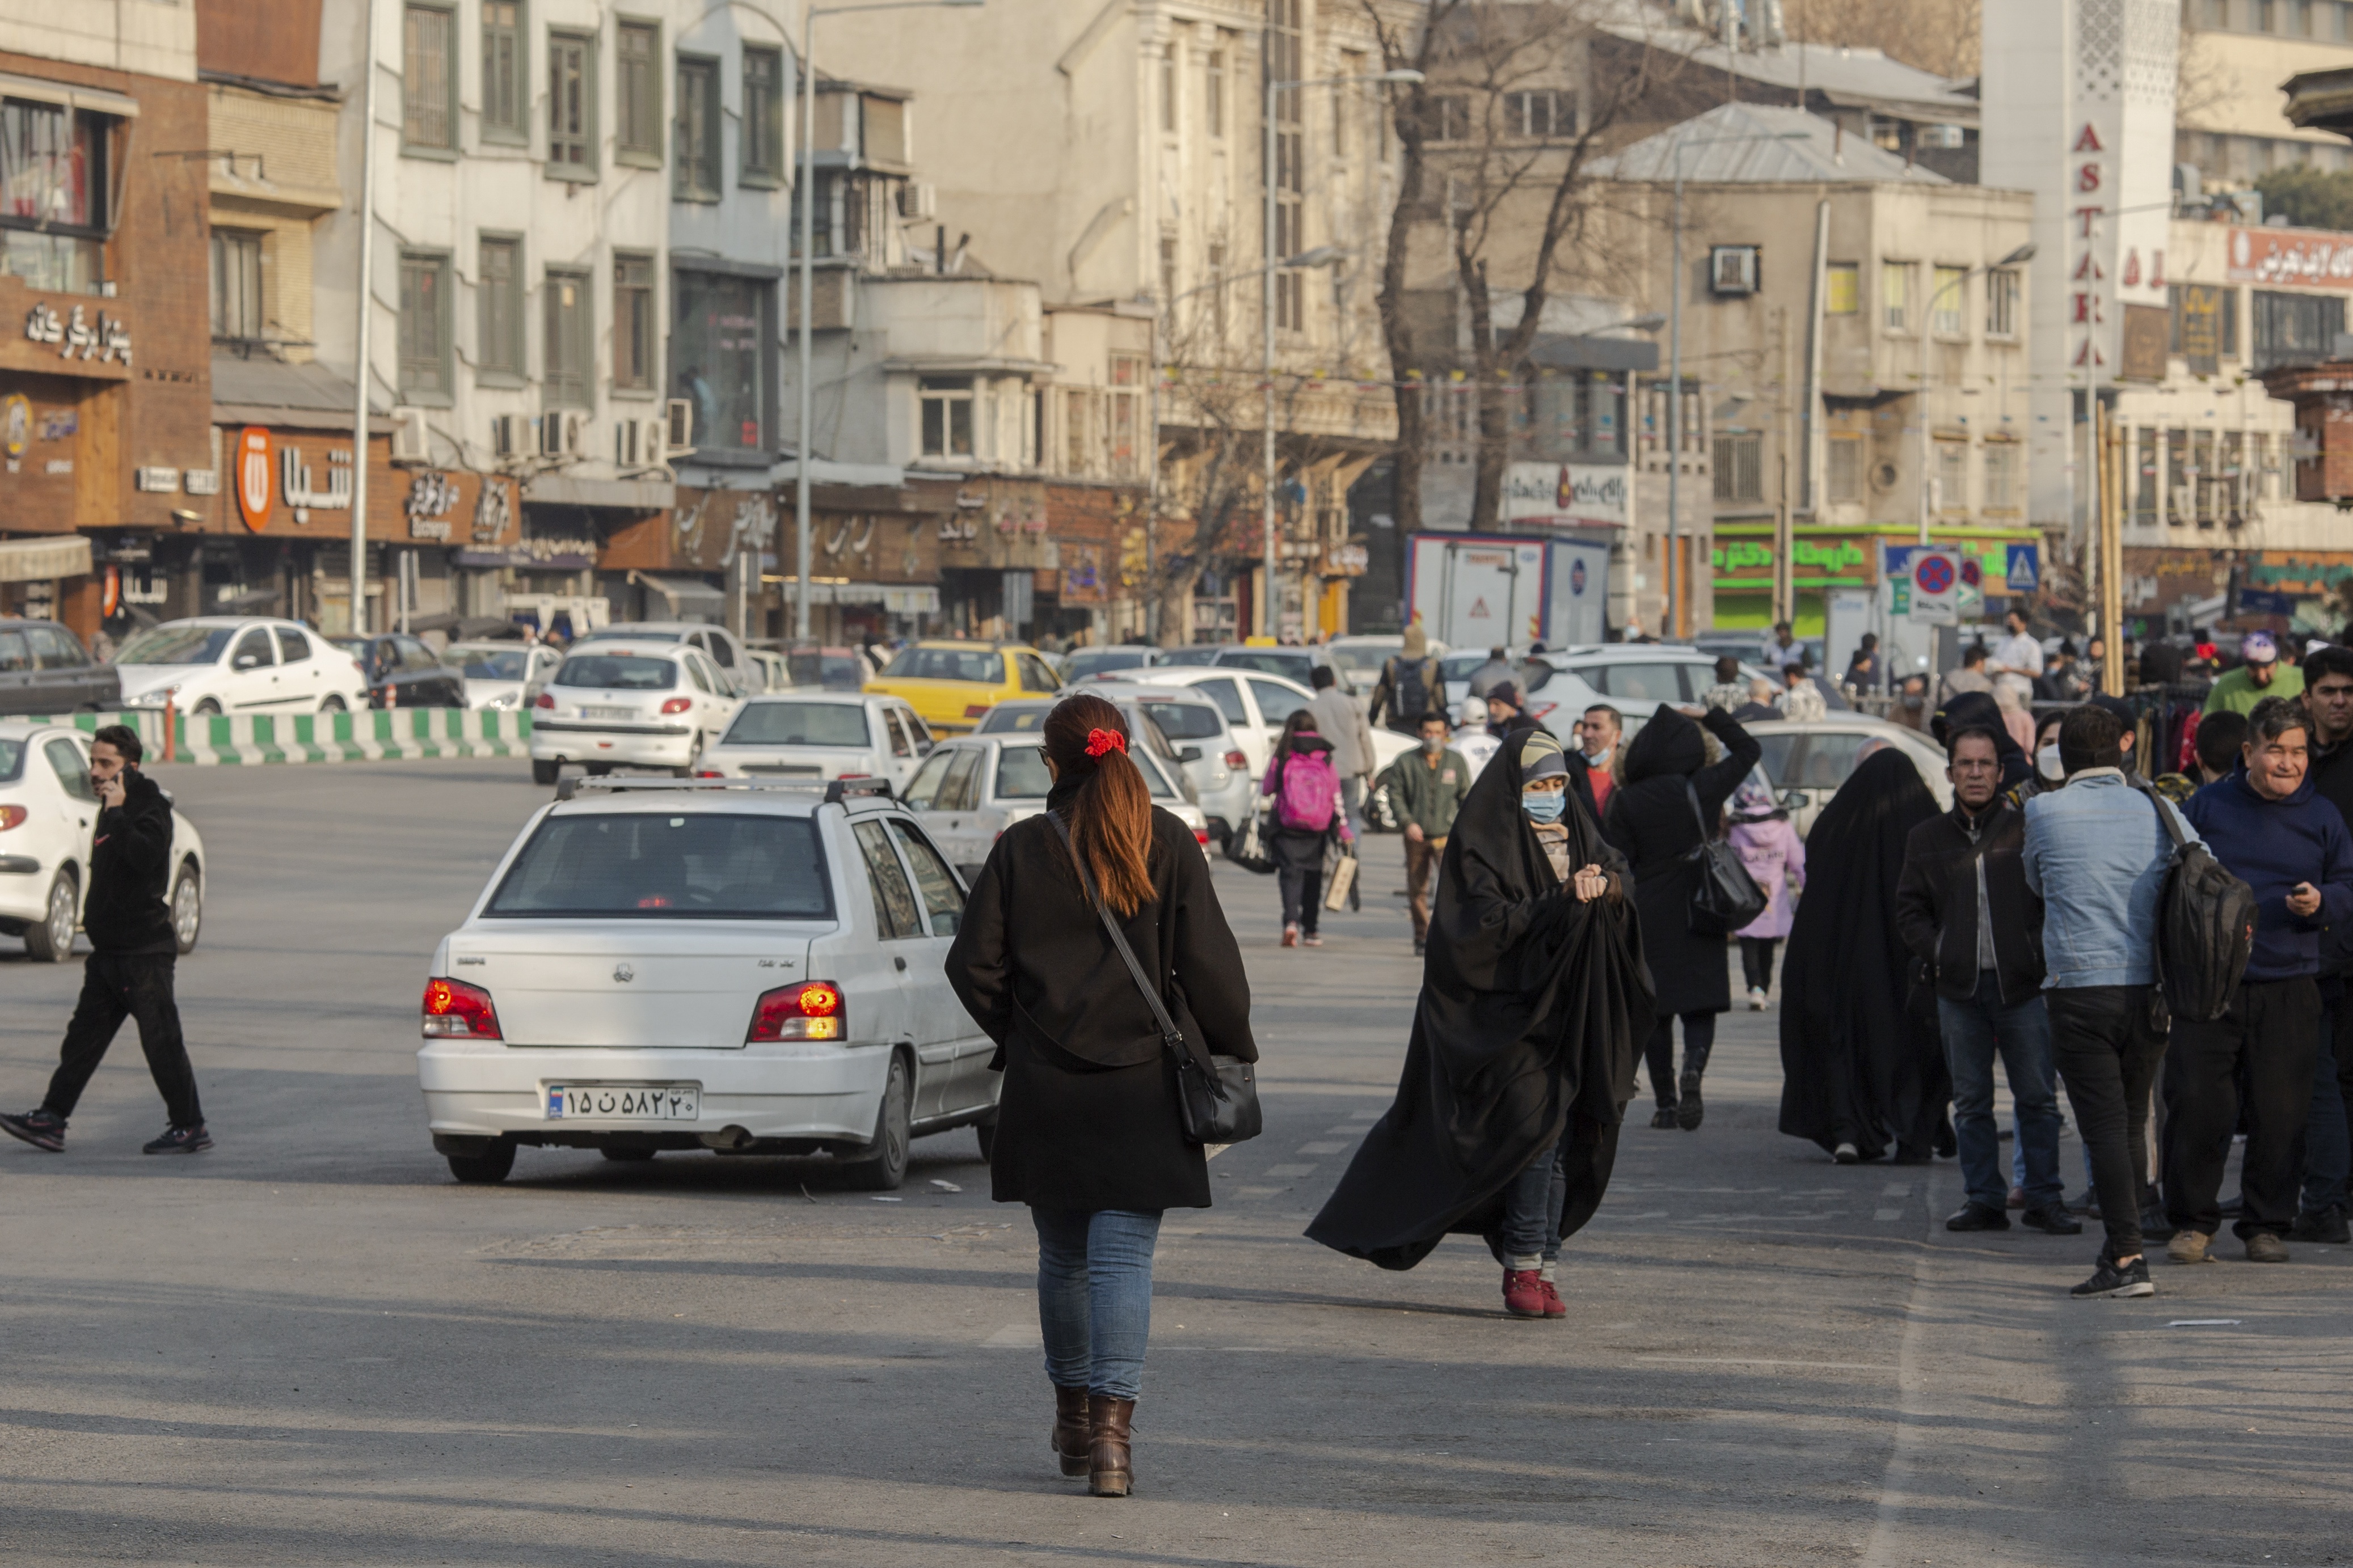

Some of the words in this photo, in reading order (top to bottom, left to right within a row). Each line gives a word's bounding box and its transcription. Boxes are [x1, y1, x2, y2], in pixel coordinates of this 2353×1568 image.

[2073, 121, 2105, 367] ASTARA
[26, 301, 64, 343] کافه
[62, 304, 99, 361] برگر
